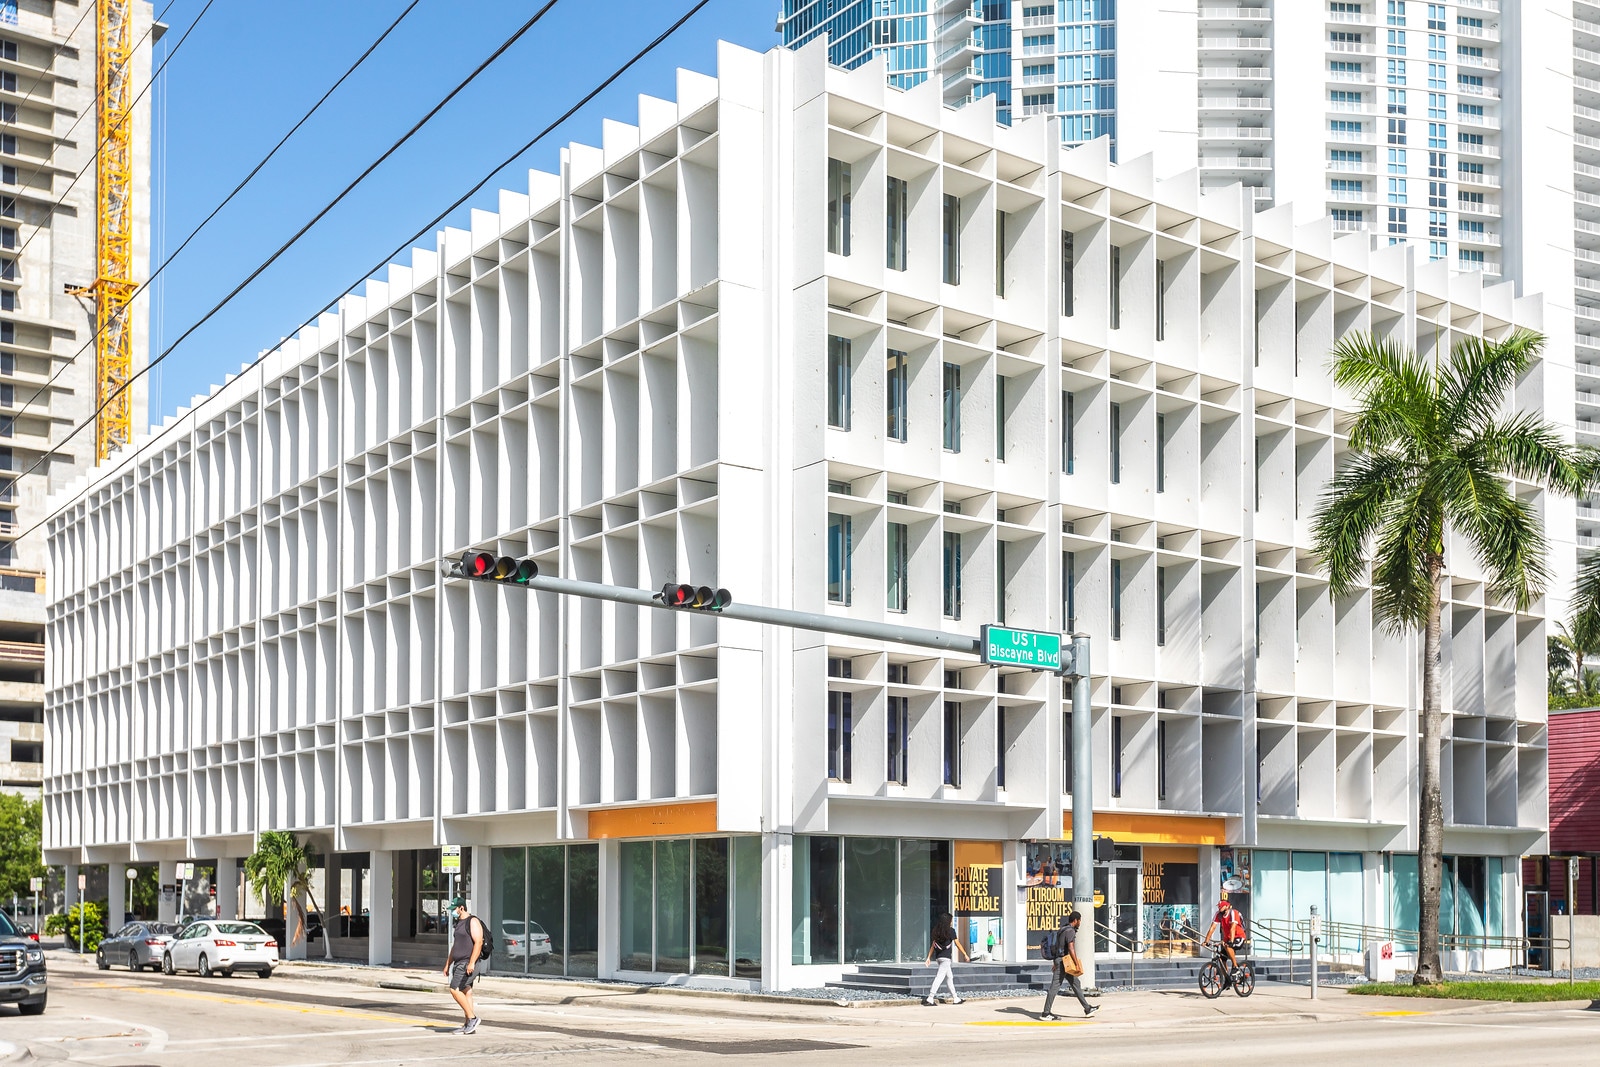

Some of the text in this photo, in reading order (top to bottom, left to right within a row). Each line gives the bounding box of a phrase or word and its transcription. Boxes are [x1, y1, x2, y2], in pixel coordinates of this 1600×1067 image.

[1012, 631, 1037, 648] US 1
[990, 643, 1058, 664] Biscayne Blvd
[954, 866, 989, 881] PRIVATE
[954, 882, 989, 897] OFFICES
[1142, 876, 1161, 889] YOUR
[1026, 887, 1065, 901] ULTIROOM
[1142, 890, 1165, 903] STORY
[954, 896, 1000, 911] AVAILABLE
[1026, 902, 1073, 916] ARTSUITES
[1026, 916, 1061, 930] AILABLE
